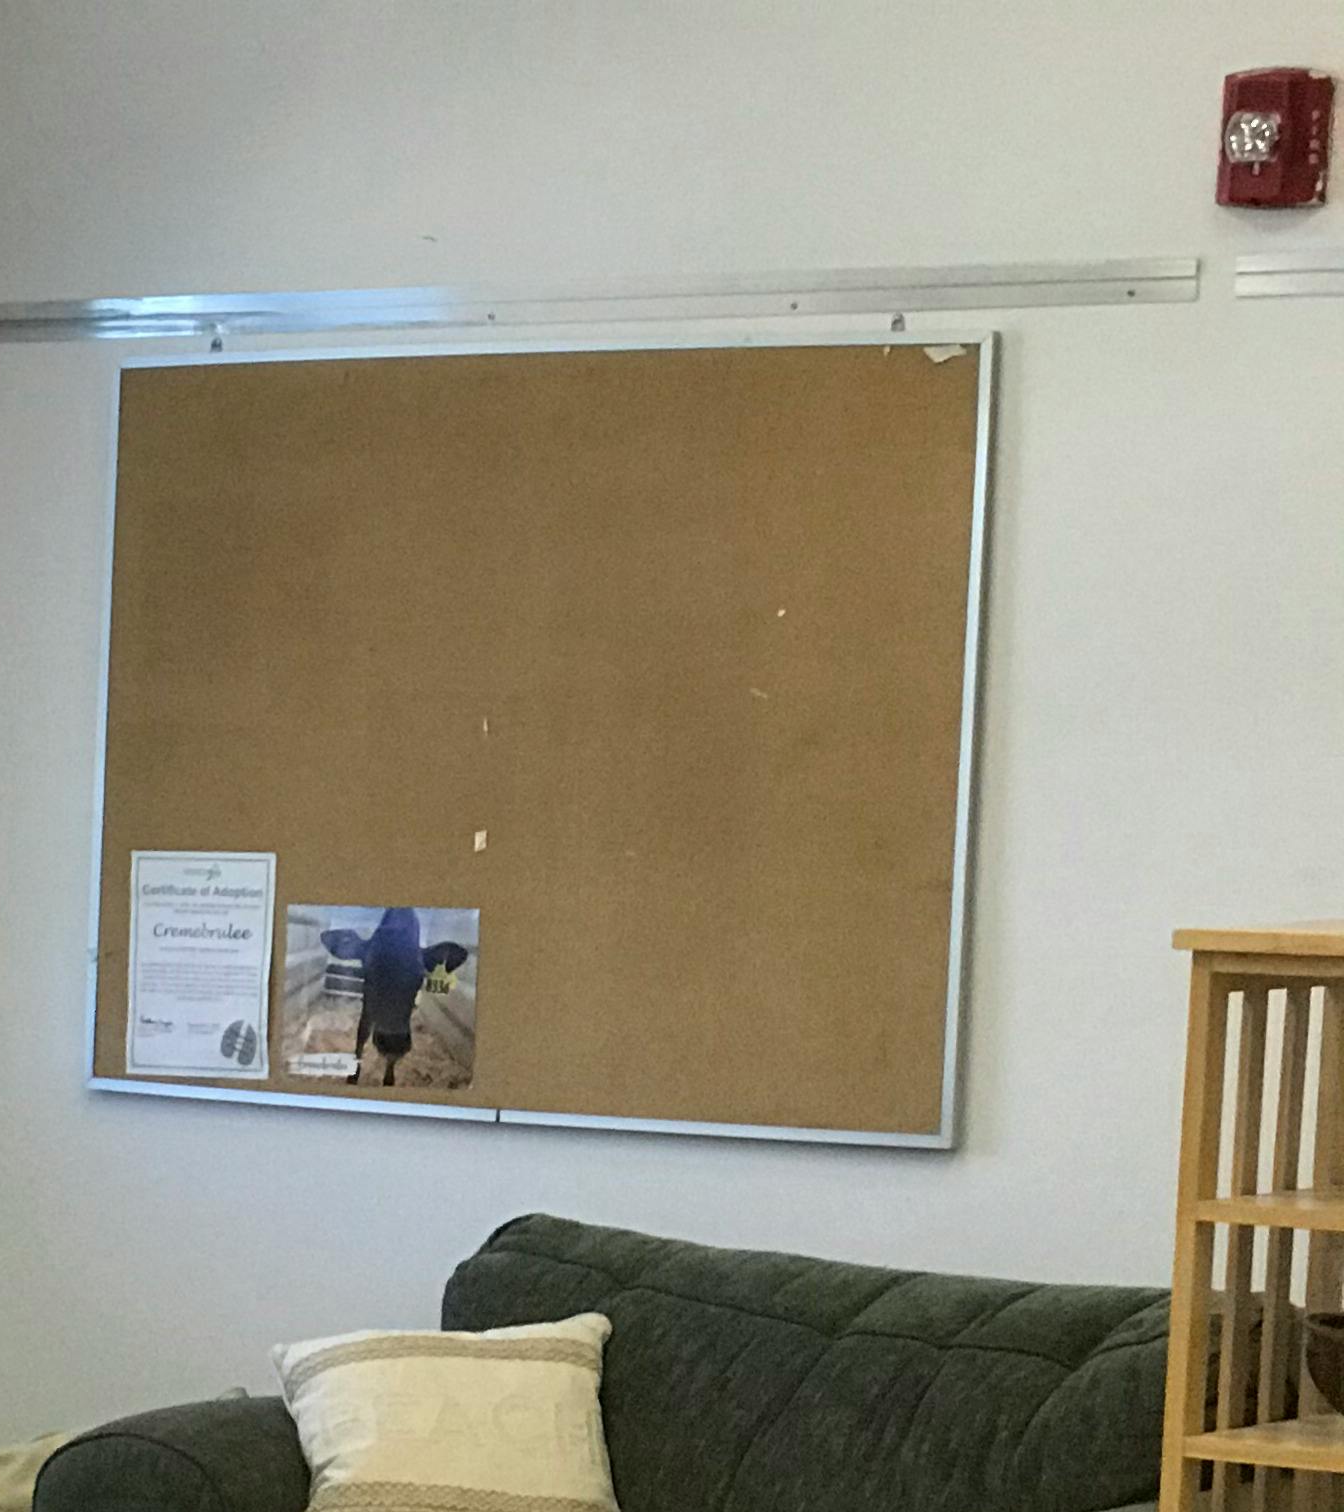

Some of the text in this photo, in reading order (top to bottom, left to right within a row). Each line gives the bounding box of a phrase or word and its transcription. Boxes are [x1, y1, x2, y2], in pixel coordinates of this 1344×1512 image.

[142, 884, 197, 897] Certificate
[213, 886, 264, 899] Adoption
[152, 922, 253, 941] Cremebrulee
